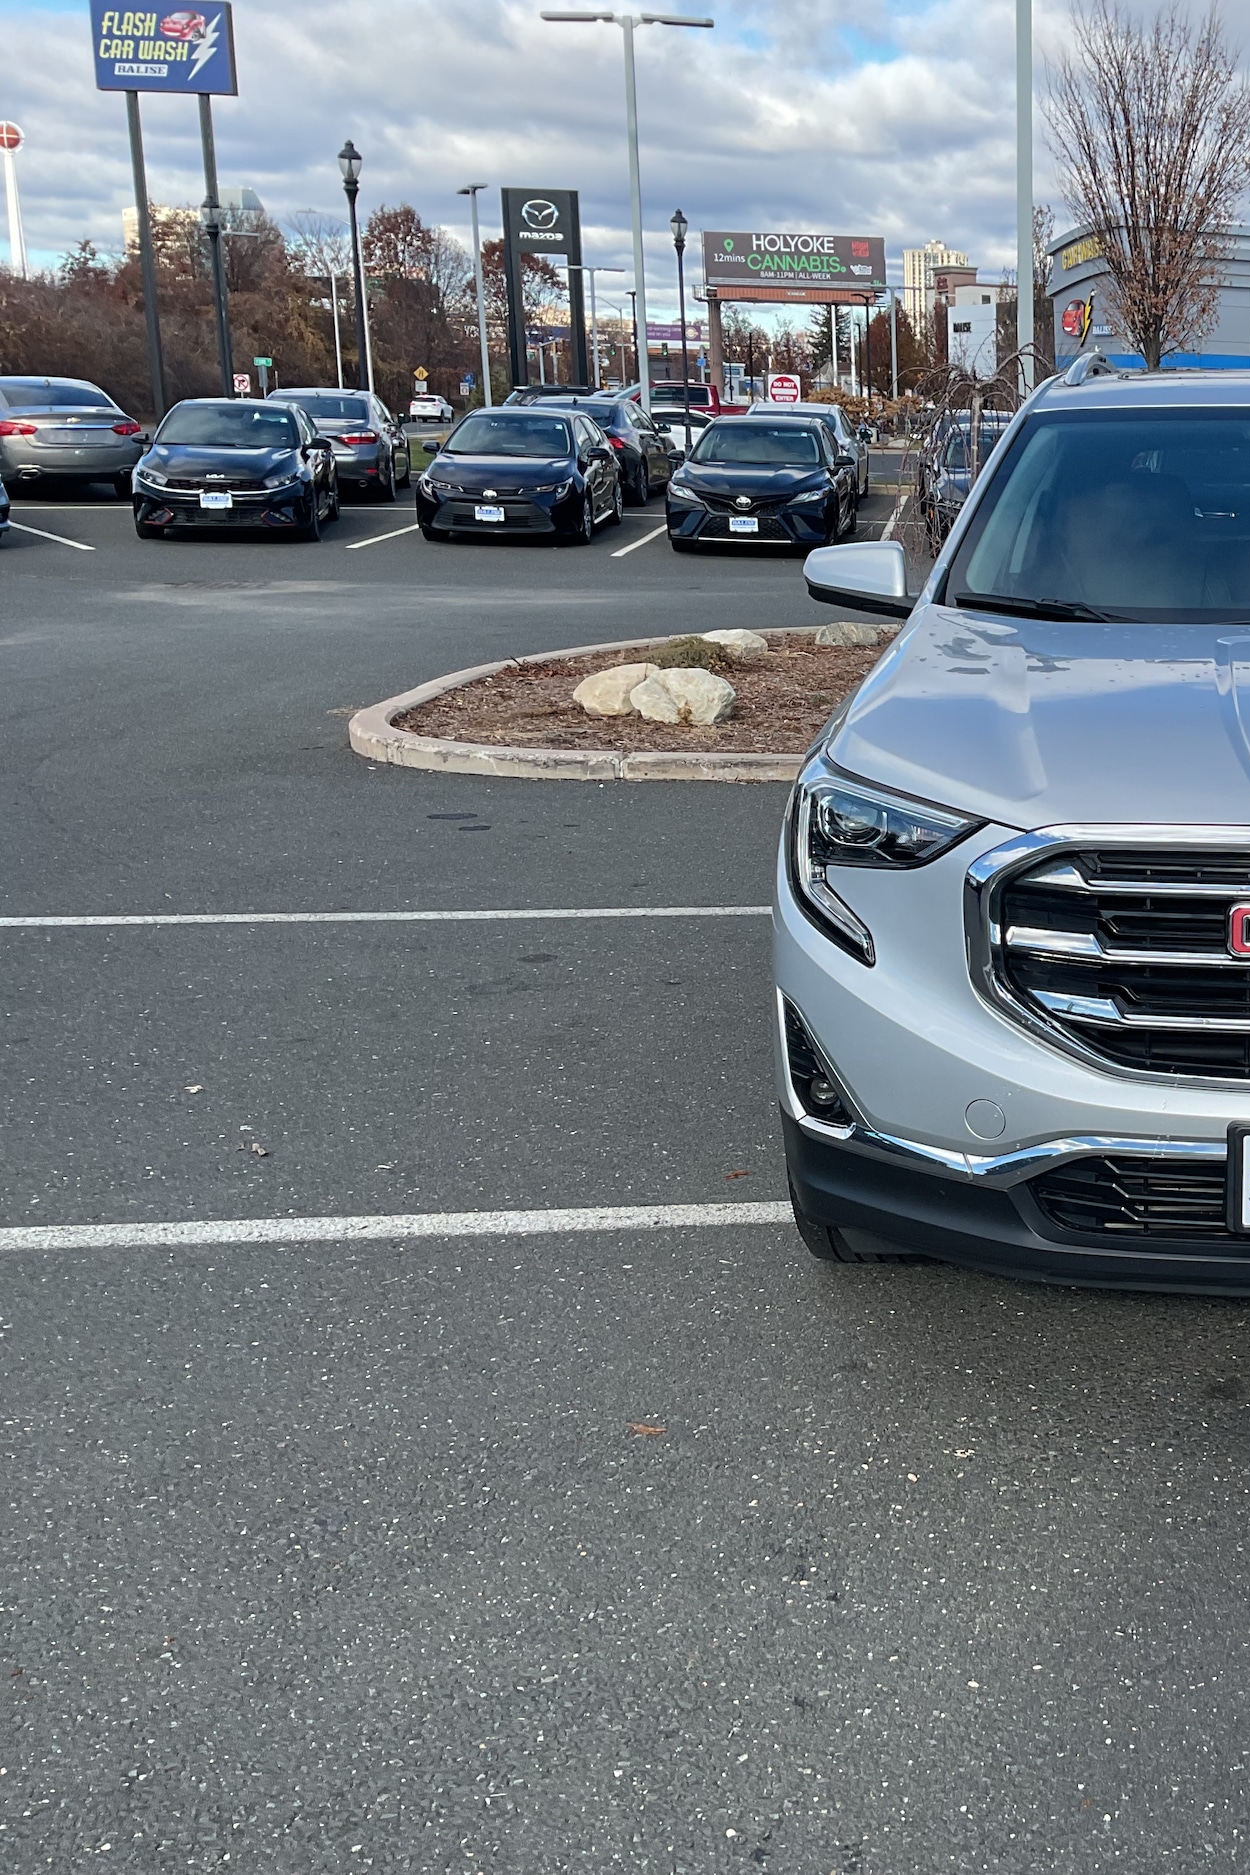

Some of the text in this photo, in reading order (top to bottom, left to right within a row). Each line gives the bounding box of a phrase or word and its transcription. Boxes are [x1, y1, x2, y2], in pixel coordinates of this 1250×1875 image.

[102, 11, 157, 37] FLASH
[99, 38, 189, 61] CAR WASH
[116, 65, 165, 75] BALISE
[752, 234, 834, 254] HOLYOKE
[714, 253, 746, 263] 12mins
[747, 253, 846, 273] CANNABIS.
[1061, 244, 1079, 270] CAR
[760, 271, 794, 279] 8AM-11PM
